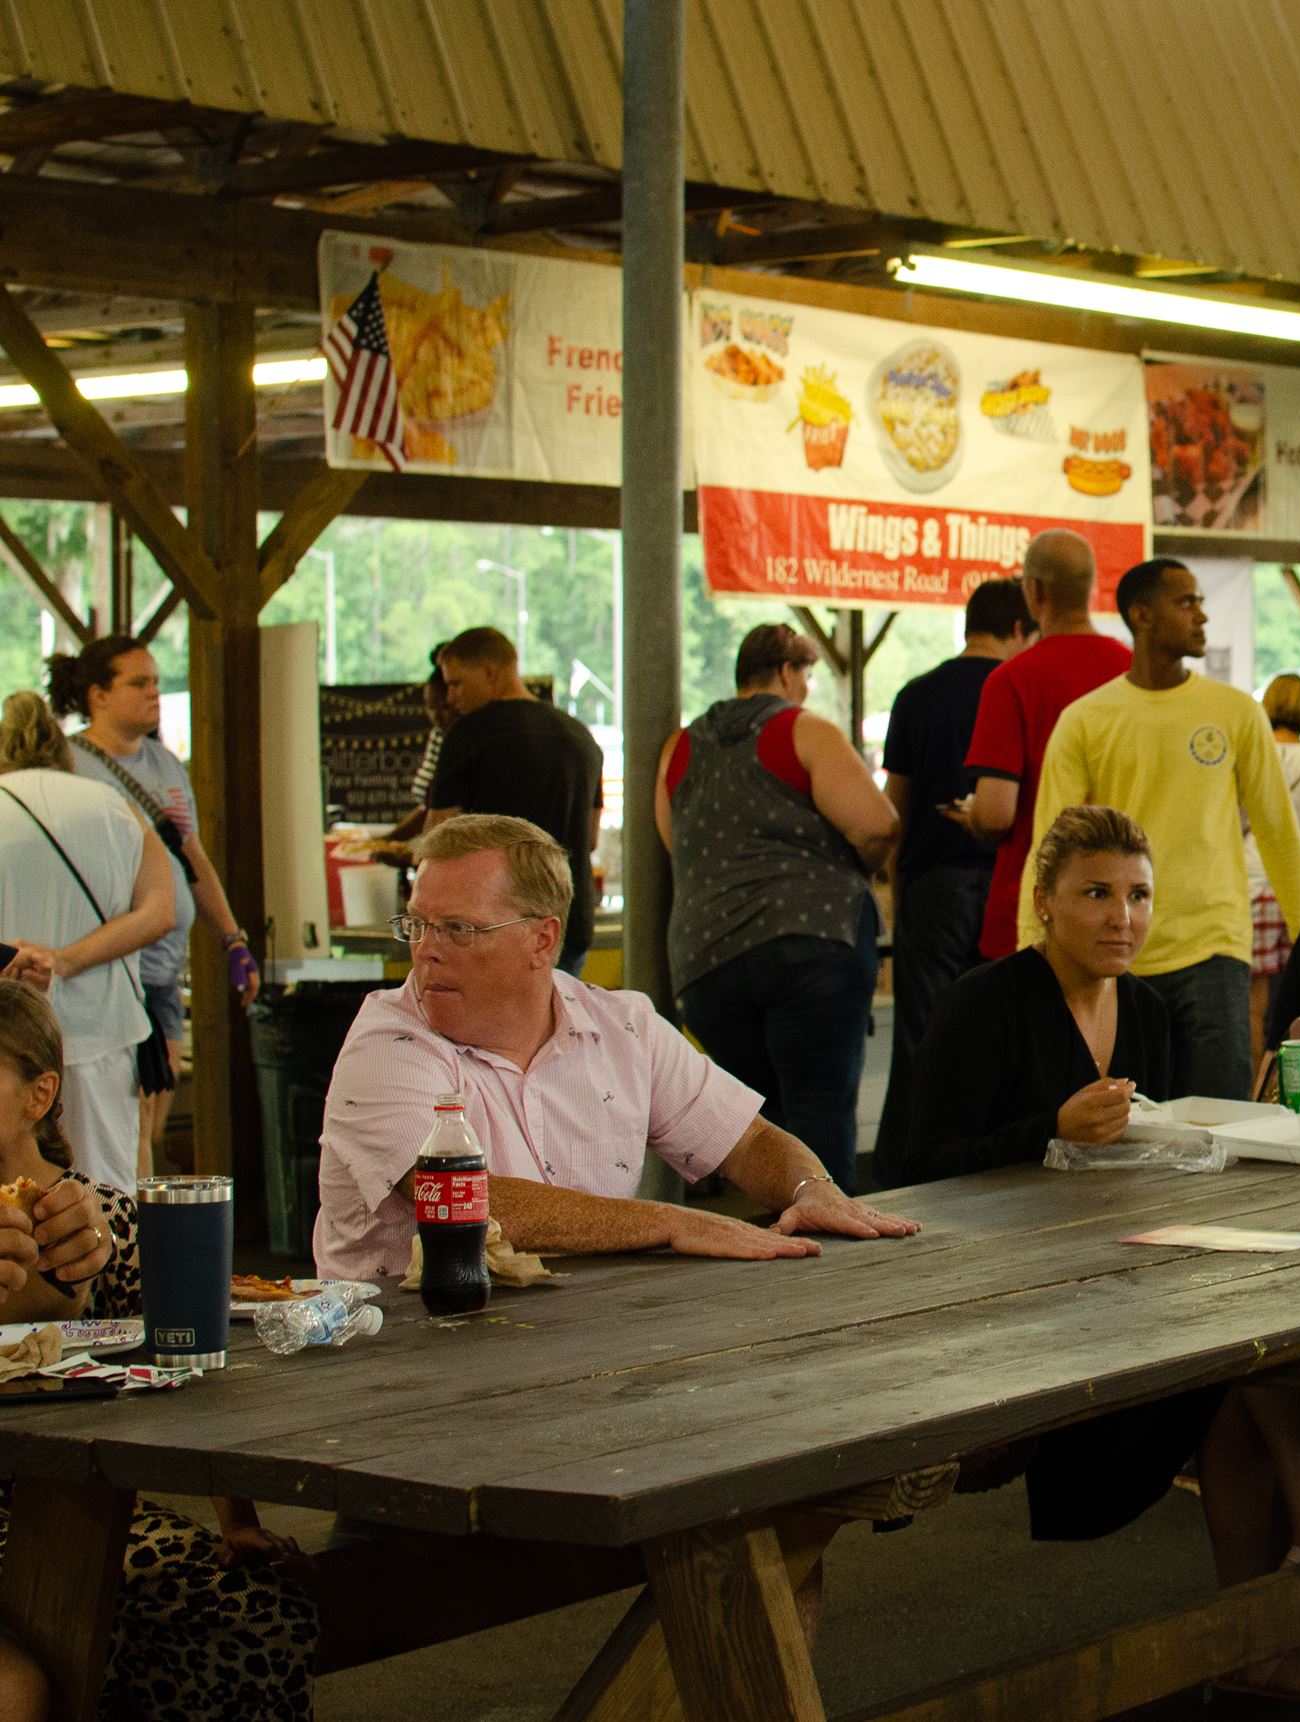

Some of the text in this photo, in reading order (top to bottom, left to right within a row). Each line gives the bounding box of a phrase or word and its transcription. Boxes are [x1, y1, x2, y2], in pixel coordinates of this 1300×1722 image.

[827, 502, 1030, 569] Wings & Things
[765, 555, 799, 585] 182
[903, 565, 949, 594] Road
[417, 1181, 444, 1202] Cola
[158, 1331, 191, 1344] YETI
